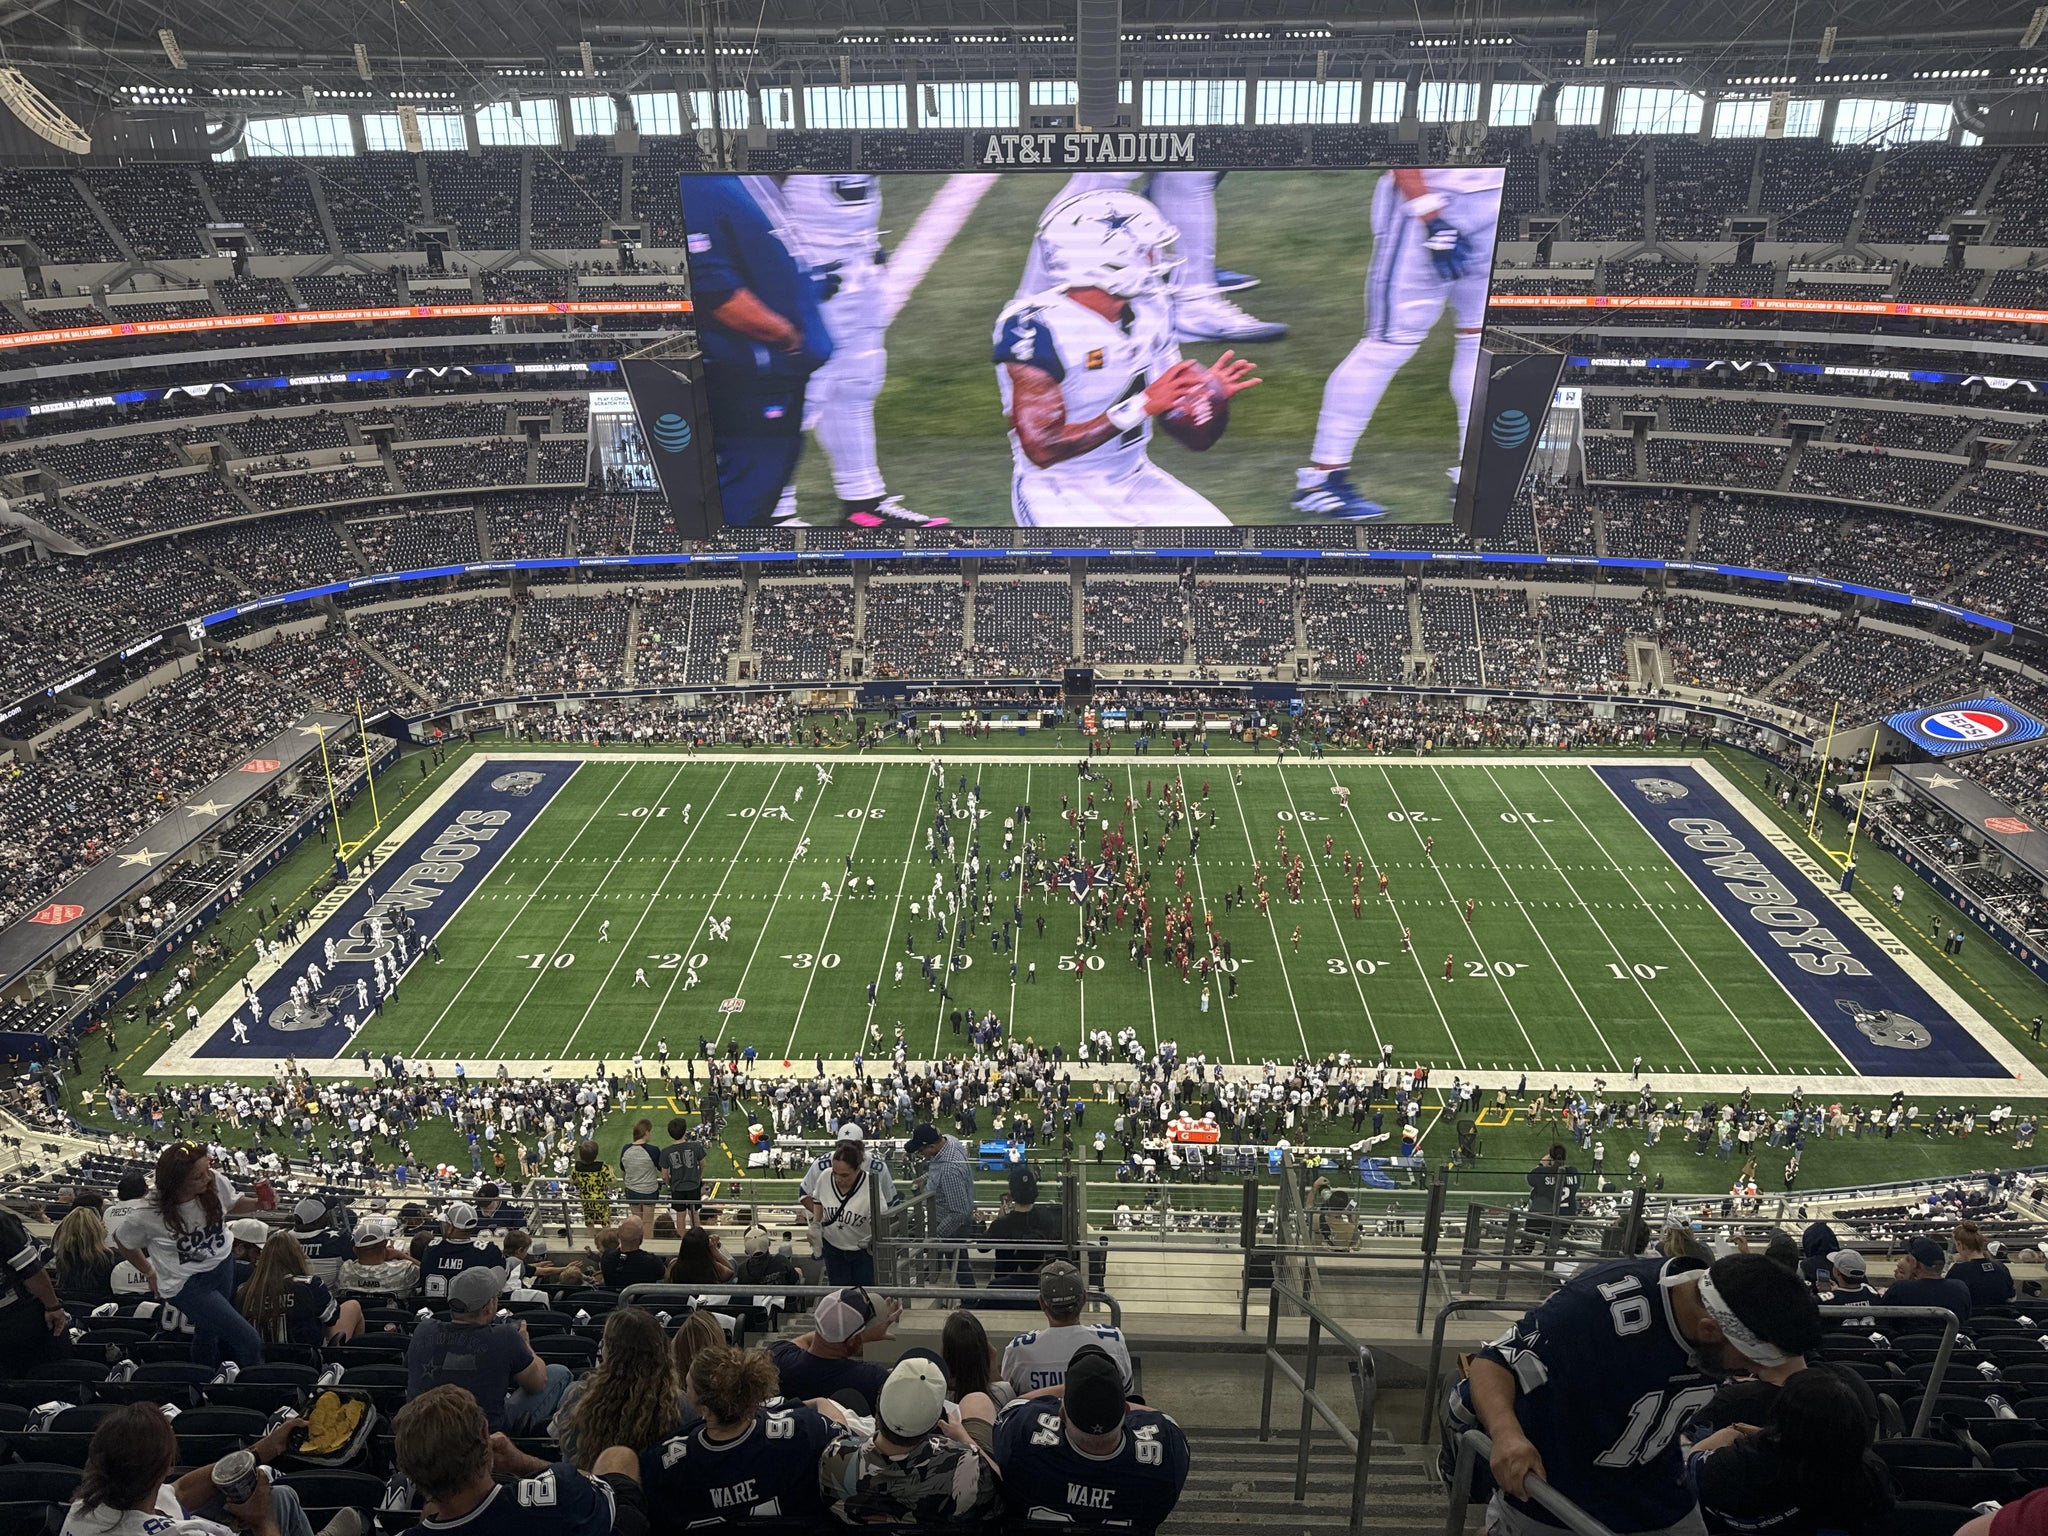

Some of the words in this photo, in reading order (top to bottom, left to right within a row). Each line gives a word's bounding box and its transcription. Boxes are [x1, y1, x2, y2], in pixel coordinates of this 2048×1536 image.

[983, 134, 1056, 164] AT&T
[1063, 133, 1196, 163] STADIUM
[30, 332, 53, 341] LOCATION
[1591, 358, 1620, 366] OCTOBER
[290, 376, 320, 386] OCTOBER
[1871, 370, 1890, 378] LOOP
[30, 406, 40, 415] ED
[77, 399, 94, 409] LOOP
[190, 626, 204, 638] 25
[54, 668, 97, 694] Blockchain.com
[1941, 714, 1988, 738] PEPSI
[632, 808, 671, 818] 10
[847, 808, 886, 819] 30
[1277, 811, 1316, 822] 30
[1388, 812, 1428, 822] 20
[1500, 812, 1544, 823] 10
[1667, 818, 1873, 977] COWBOYS
[1766, 833, 1790, 844] IT
[1783, 848, 1832, 884] TAKES
[1824, 888, 1860, 910] ALL
[1854, 916, 1886, 932] OF
[1876, 938, 1910, 956] US
[525, 953, 576, 969] 10
[658, 953, 709, 969] 20
[792, 954, 841, 969] 30
[1057, 955, 1105, 970] 50
[1327, 959, 1376, 975] 30
[1464, 961, 1516, 978] 20
[1605, 963, 1656, 980] 10
[438, 1258, 464, 1270] LAMB
[128, 1272, 148, 1284] LAM
[358, 1280, 380, 1288] LAMB
[1596, 1275, 1652, 1336] 10
[1030, 1412, 1060, 1446] 94
[1132, 1424, 1163, 1466] 94
[710, 1478, 759, 1508] WARE
[1066, 1482, 1116, 1510] WARE
